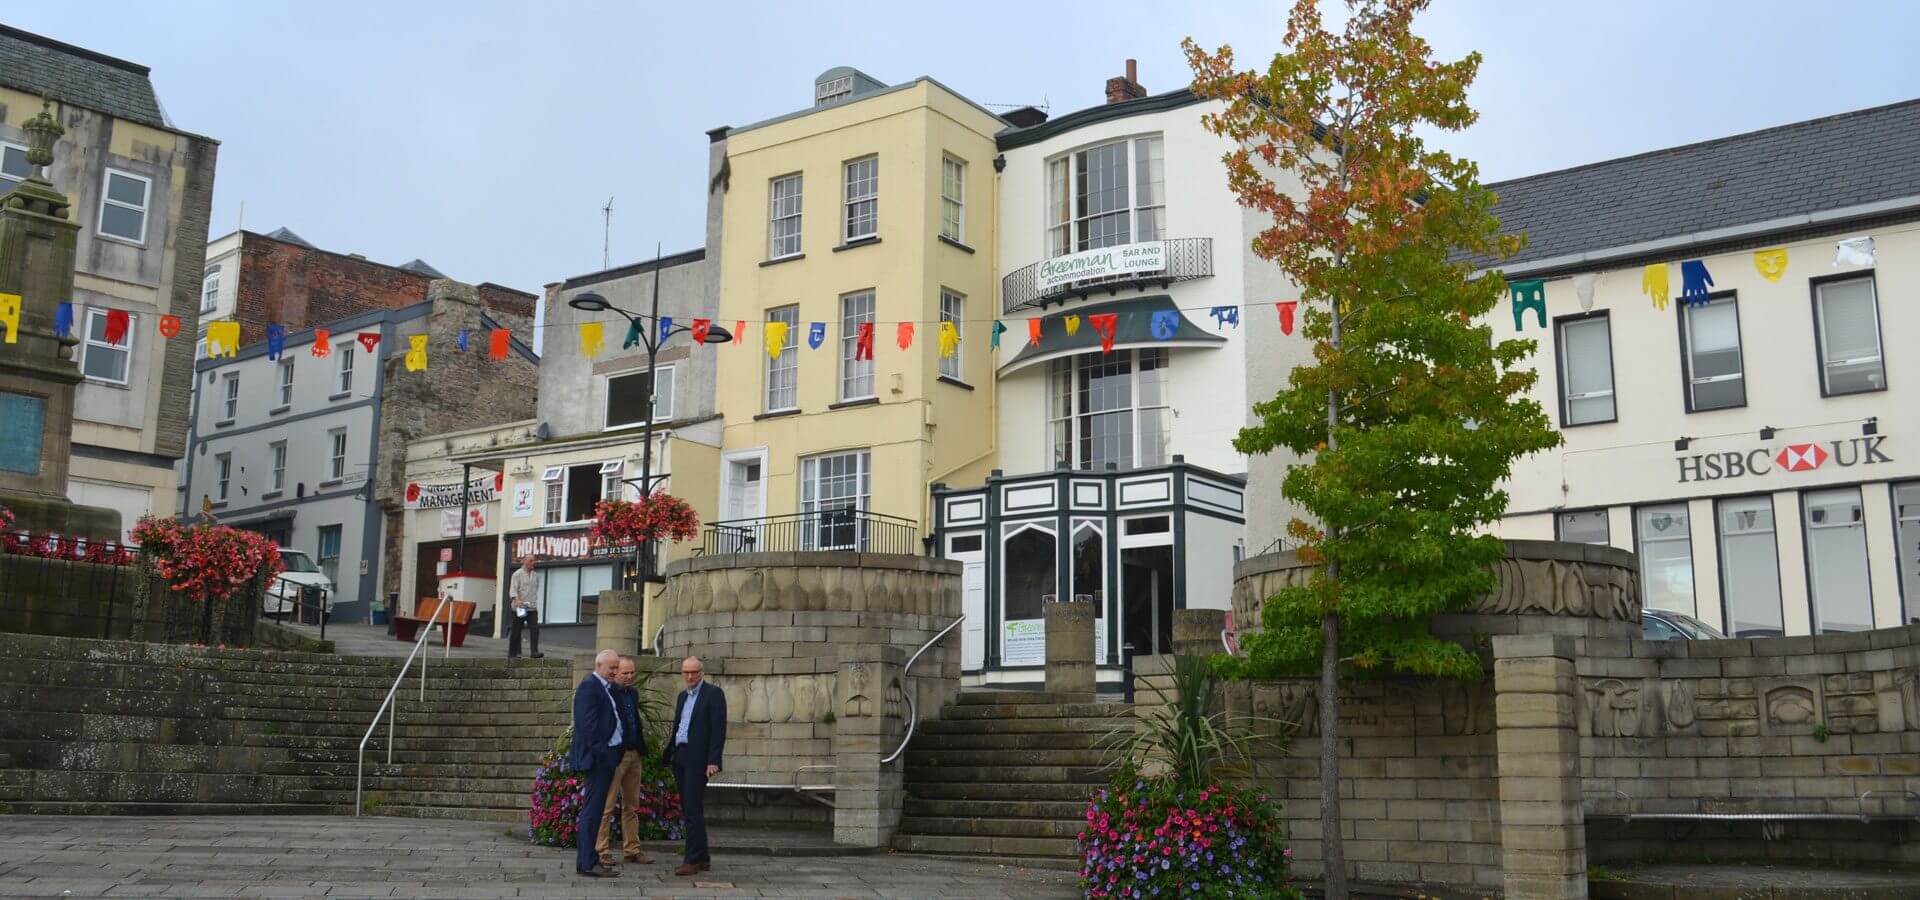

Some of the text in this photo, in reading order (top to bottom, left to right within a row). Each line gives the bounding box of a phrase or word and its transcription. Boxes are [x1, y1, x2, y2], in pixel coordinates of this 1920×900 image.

[1122, 246, 1161, 258] BAR AND
[1040, 252, 1117, 279] Greenman
[1124, 257, 1160, 269] LOUNGE
[1046, 266, 1106, 285] accommodation
[1676, 435, 1894, 483] HSBC UK
[420, 488, 495, 508] MANAGEMENT
[517, 535, 588, 558] HOLLYWOOD
